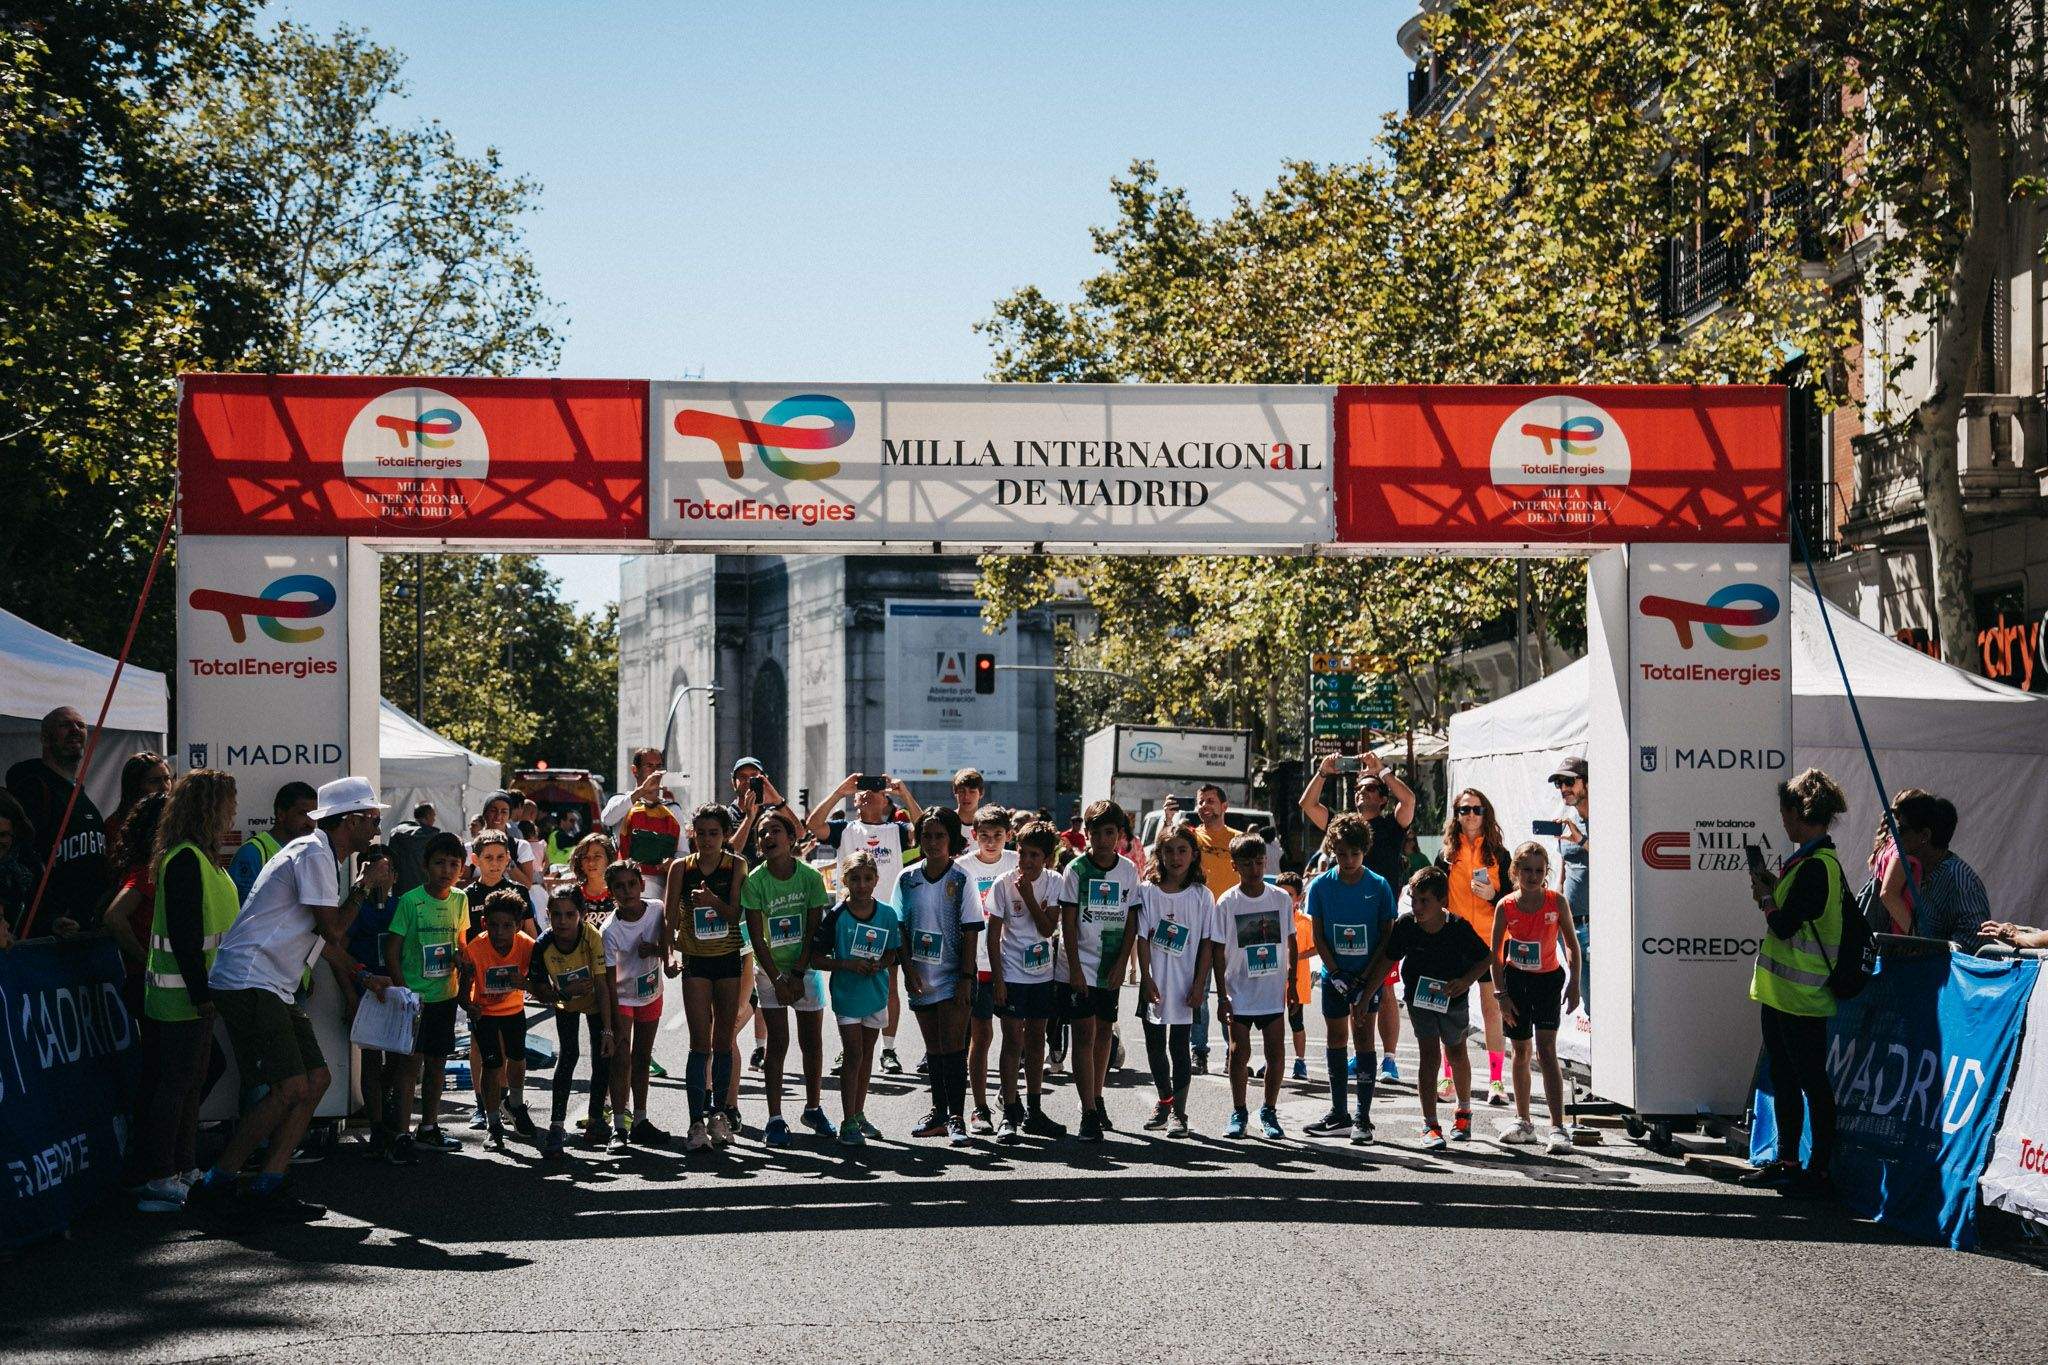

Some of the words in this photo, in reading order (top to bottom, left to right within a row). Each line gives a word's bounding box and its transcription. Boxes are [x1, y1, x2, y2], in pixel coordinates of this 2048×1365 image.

[375, 456, 462, 470] TotalEnergies
[881, 438, 1005, 468] MILLA
[1013, 440, 1322, 471] INTERNACIONaL
[1521, 464, 1605, 476] TotalEnergies
[397, 481, 438, 492] MILLA
[995, 478, 1047, 506] DE
[1057, 478, 1209, 507] MADRID
[1542, 488, 1581, 499] MILLA
[381, 506, 400, 517] DE
[403, 506, 453, 517] MADRID
[673, 498, 856, 526] TotalEnergies
[1528, 512, 1544, 523] DE
[1548, 512, 1596, 523] MADRID
[188, 656, 338, 679] TotalEnergies
[1640, 664, 1781, 686] TotalEnergies
[228, 743, 343, 765] MADRID
[1675, 748, 1786, 770] MADRID
[247, 817, 268, 826] new
[1695, 819, 1714, 829] new
[1716, 818, 1756, 829] balance
[1825, 1034, 1985, 1133] MADRID
